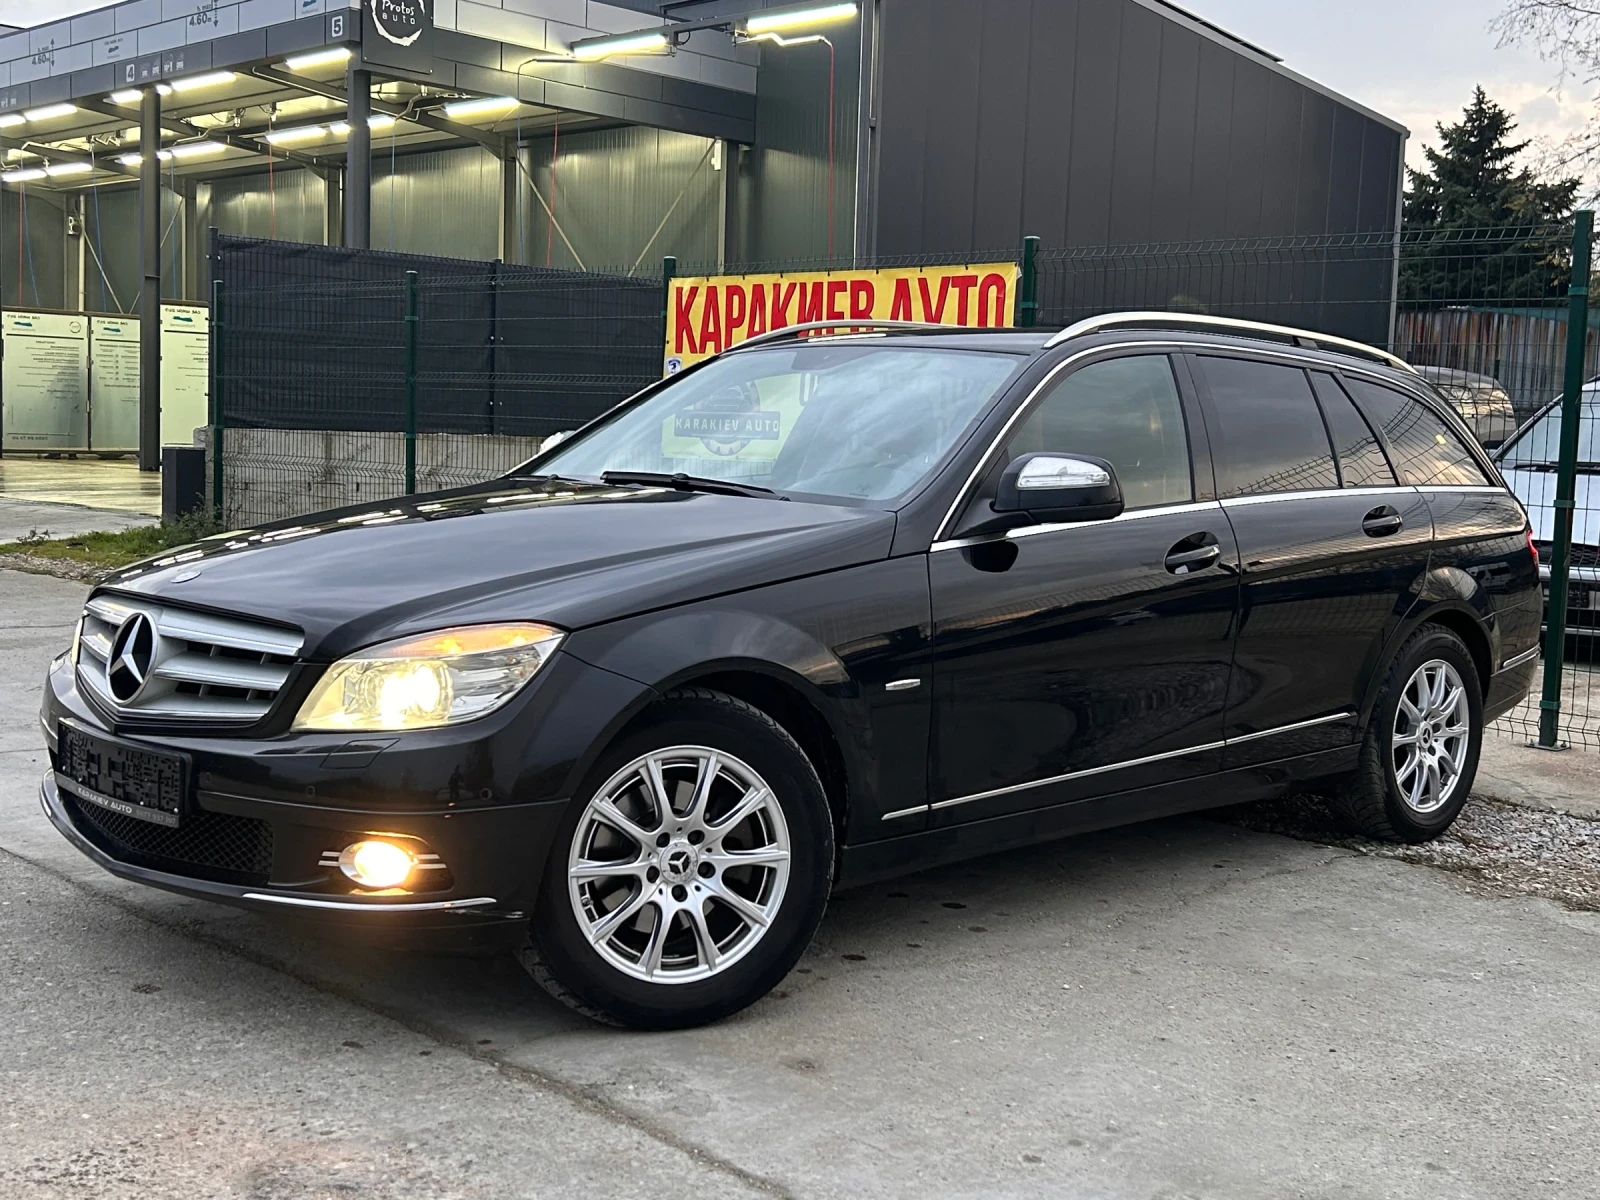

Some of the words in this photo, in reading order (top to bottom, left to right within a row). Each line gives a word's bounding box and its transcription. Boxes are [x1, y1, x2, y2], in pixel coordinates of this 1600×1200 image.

[382, 0, 415, 16] Protos
[333, 19, 342, 34] 5
[127, 67, 135, 81] 4
[674, 279, 875, 354] КАРАКИЕВ
[675, 417, 739, 431] KARAKIEV
[745, 418, 780, 432] AUTO
[110, 801, 133, 814] AUTO
